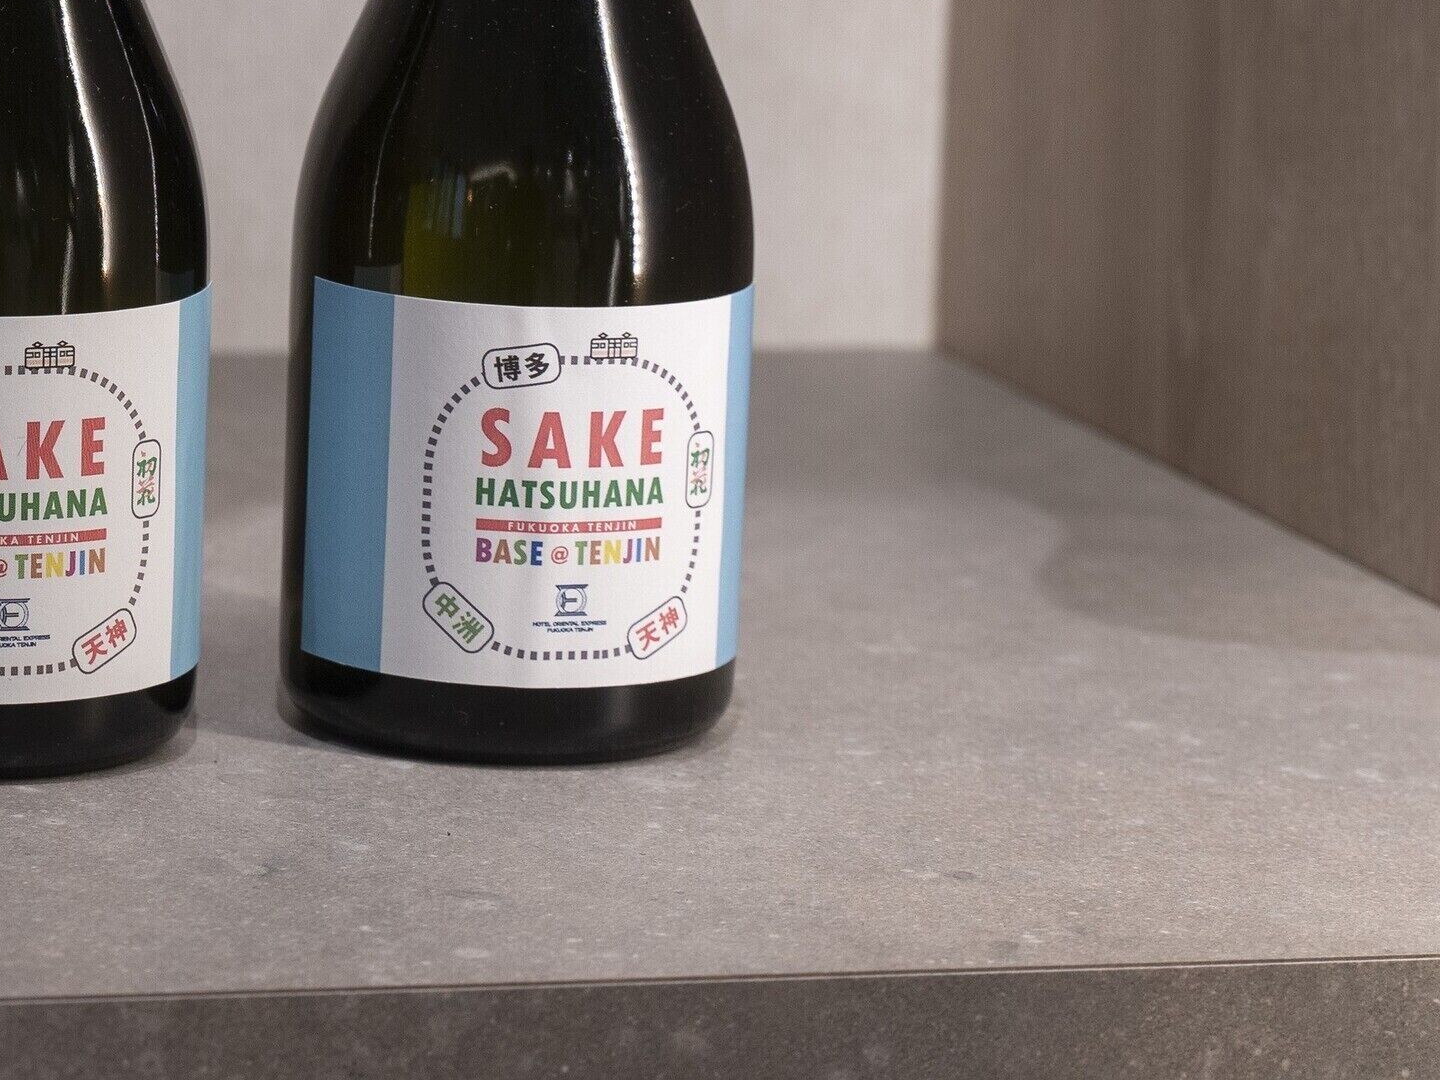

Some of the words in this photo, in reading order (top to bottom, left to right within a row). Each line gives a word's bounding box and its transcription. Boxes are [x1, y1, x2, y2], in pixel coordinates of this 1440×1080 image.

[493, 352, 550, 382] 博多
[480, 407, 664, 469] SAKE
[475, 476, 664, 509] HATSUHANA
[27, 532, 80, 545] TENJIN
[507, 521, 580, 533] FUKUOKA
[587, 520, 637, 532] TENJIN
[15, 548, 106, 580] TENJIN
[476, 537, 543, 566] BASE
[551, 546, 569, 564] @
[575, 536, 661, 566] TENJIN
[434, 591, 485, 645] 中洲
[634, 605, 682, 651] 天神
[81, 618, 129, 665] 天神
